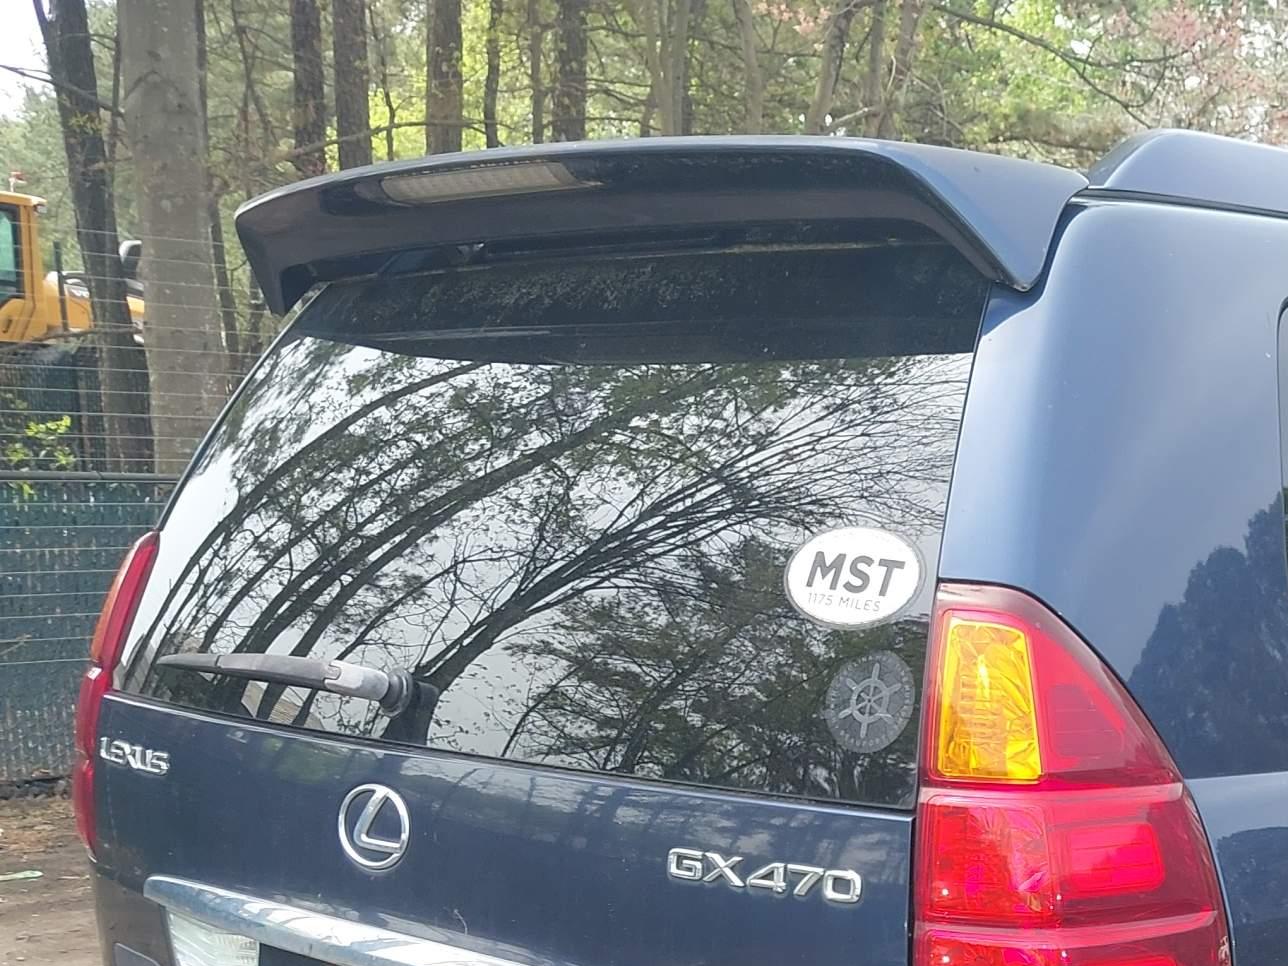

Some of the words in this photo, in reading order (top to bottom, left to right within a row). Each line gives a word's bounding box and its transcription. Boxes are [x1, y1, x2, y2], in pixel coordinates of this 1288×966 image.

[806, 551, 906, 597] MST
[807, 592, 833, 606] 1175
[838, 596, 881, 612] MILES
[100, 736, 170, 776] LEXUS
[668, 847, 863, 904] GX470
